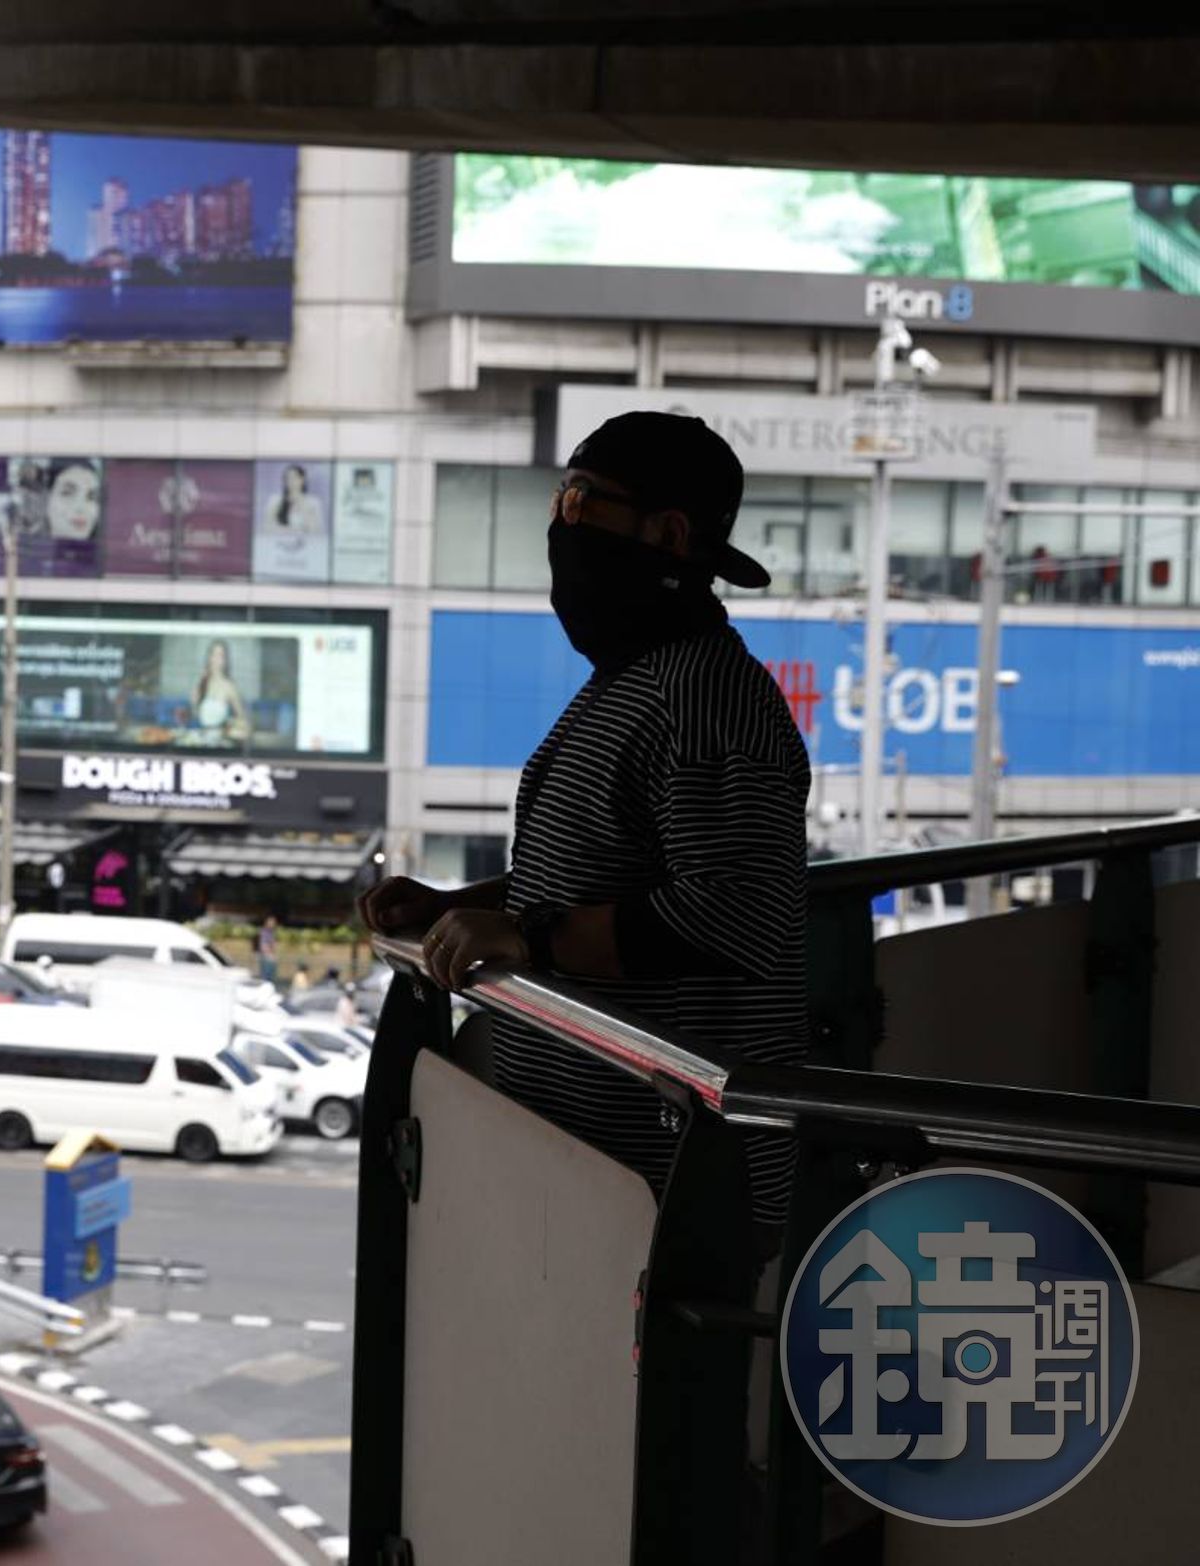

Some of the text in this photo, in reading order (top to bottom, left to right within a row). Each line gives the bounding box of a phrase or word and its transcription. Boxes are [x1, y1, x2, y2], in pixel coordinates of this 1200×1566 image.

[712, 412, 1016, 458] INTERNGE
[833, 664, 982, 735] UOB
[62, 754, 175, 792] DOUGH
